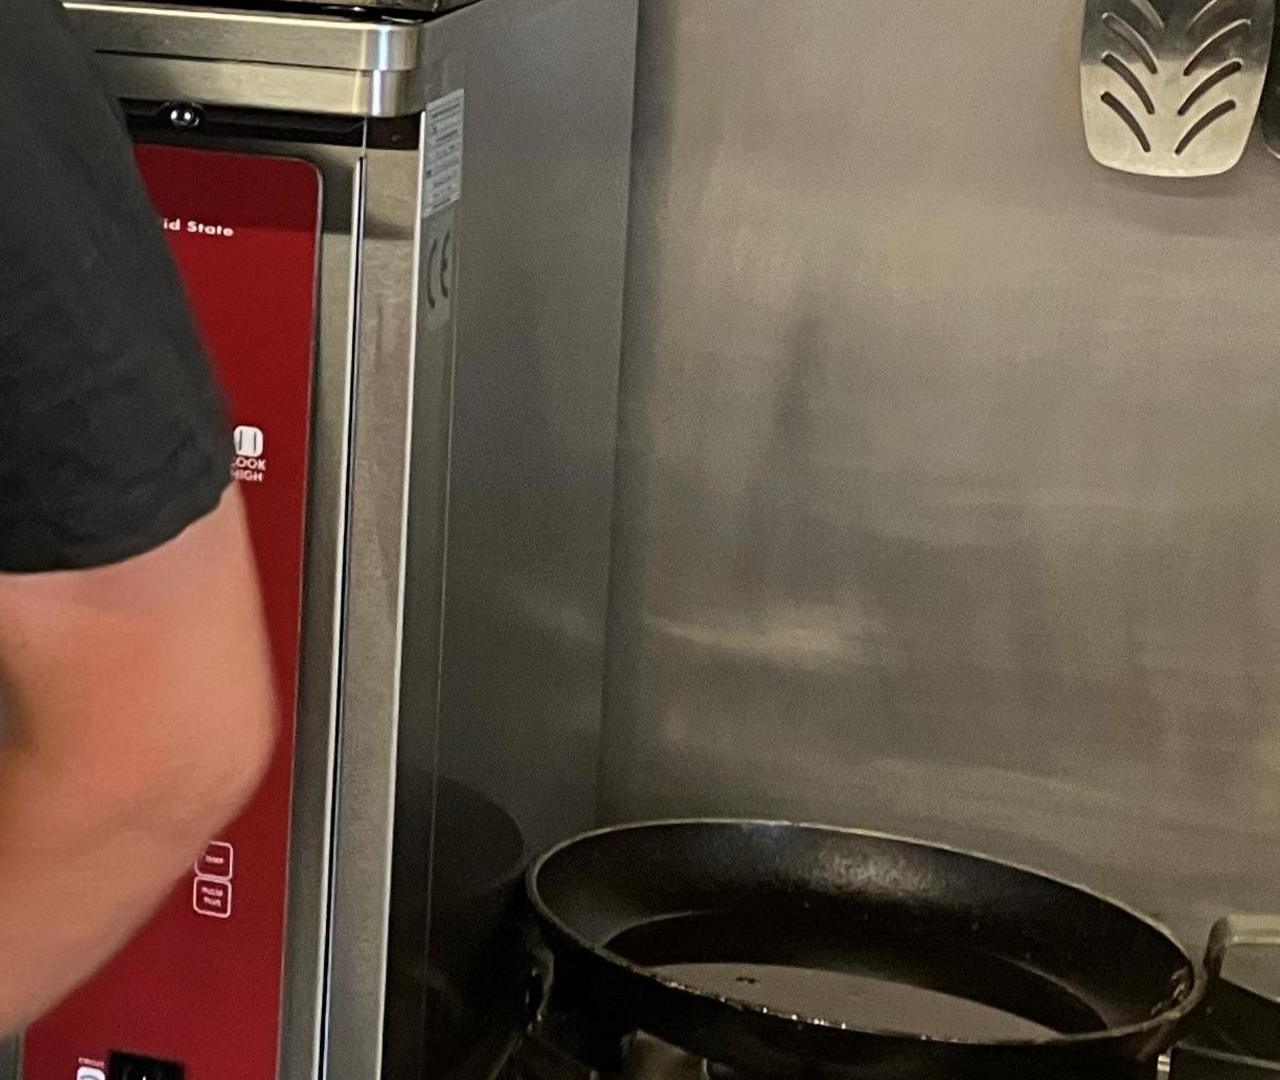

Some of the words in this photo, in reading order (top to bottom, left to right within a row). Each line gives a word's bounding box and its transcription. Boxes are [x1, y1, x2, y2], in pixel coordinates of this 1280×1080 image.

[162, 217, 181, 232] id
[186, 220, 235, 238] State
[231, 456, 267, 471] OOK
